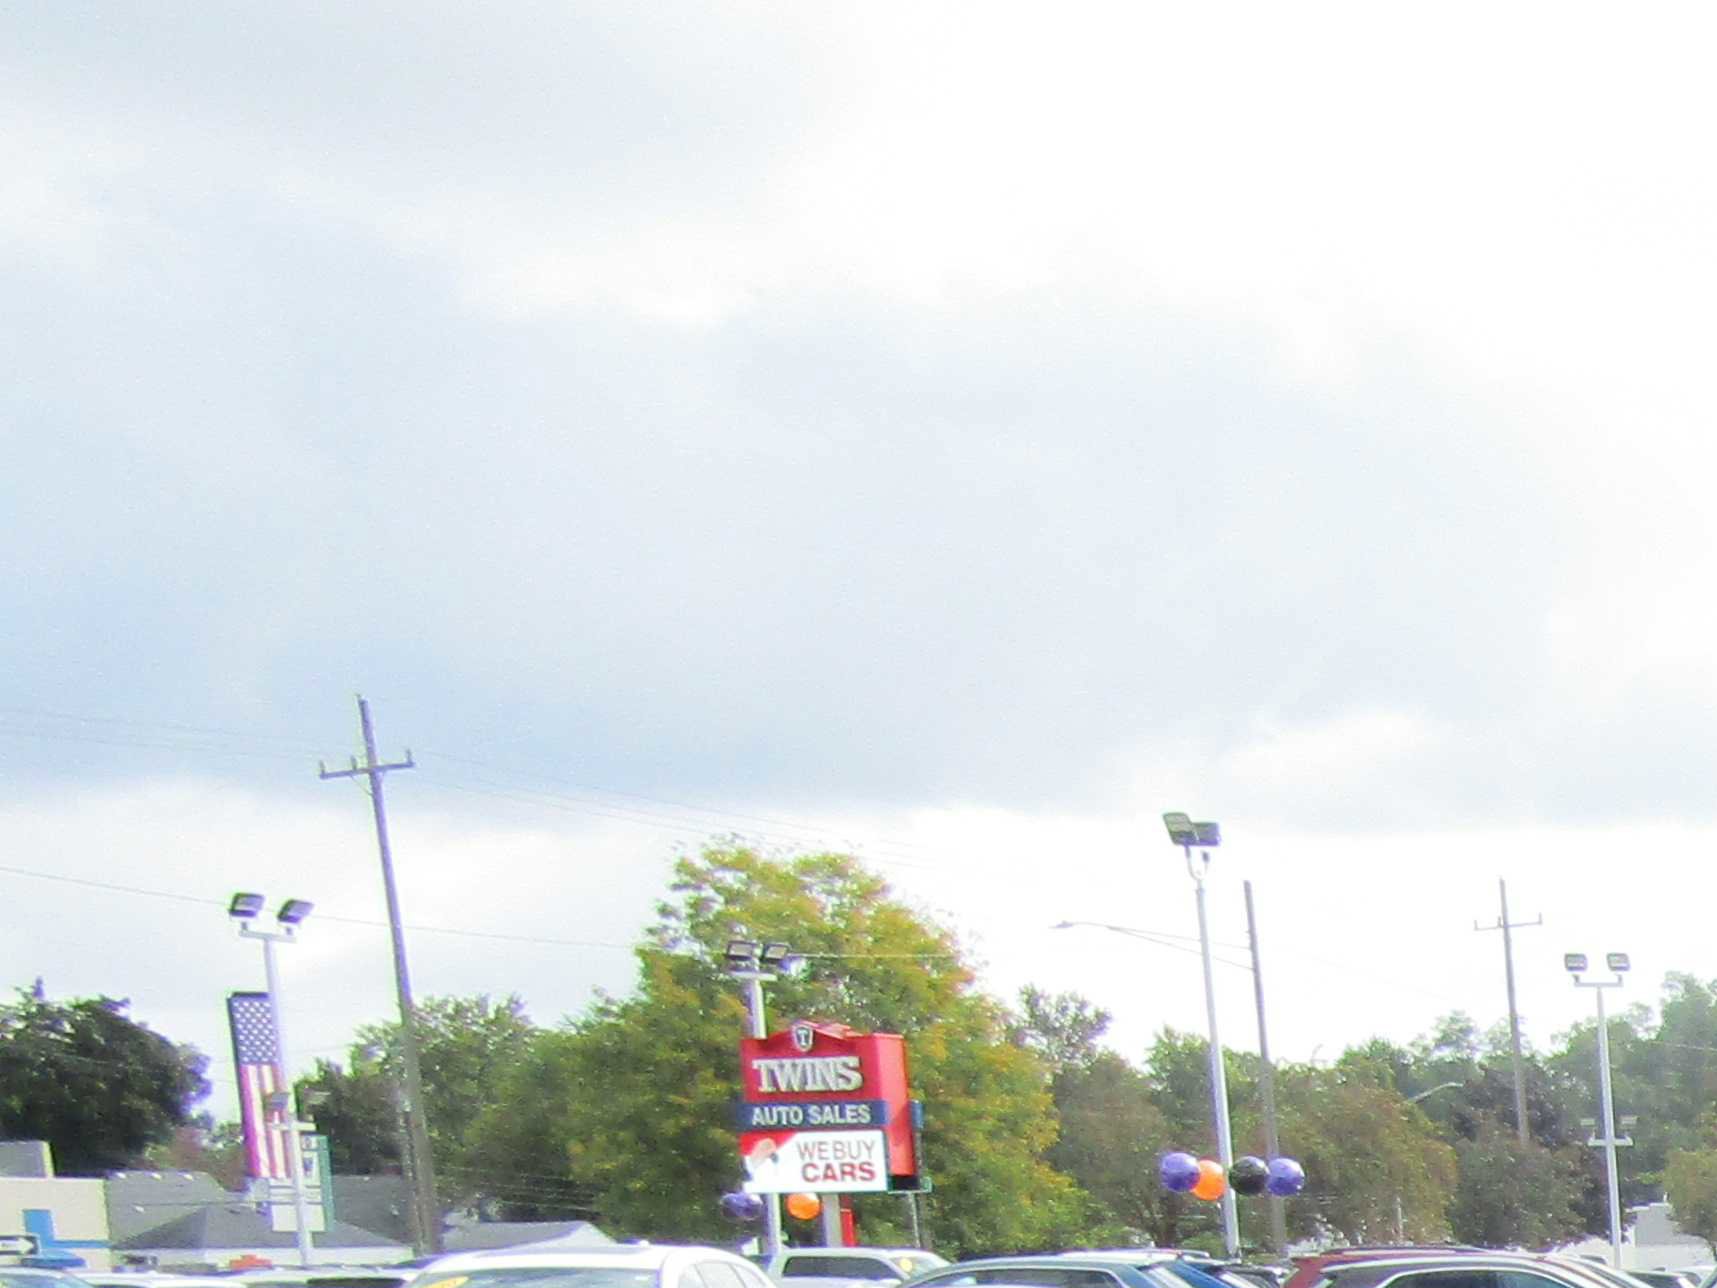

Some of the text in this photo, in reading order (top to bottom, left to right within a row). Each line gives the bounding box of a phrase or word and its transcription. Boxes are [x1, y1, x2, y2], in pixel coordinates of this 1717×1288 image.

[752, 1056, 864, 1092] TWINS
[752, 1103, 871, 1126] AUTO SALES
[796, 1140, 876, 1161] WE BUY
[801, 1162, 876, 1183] CARS
